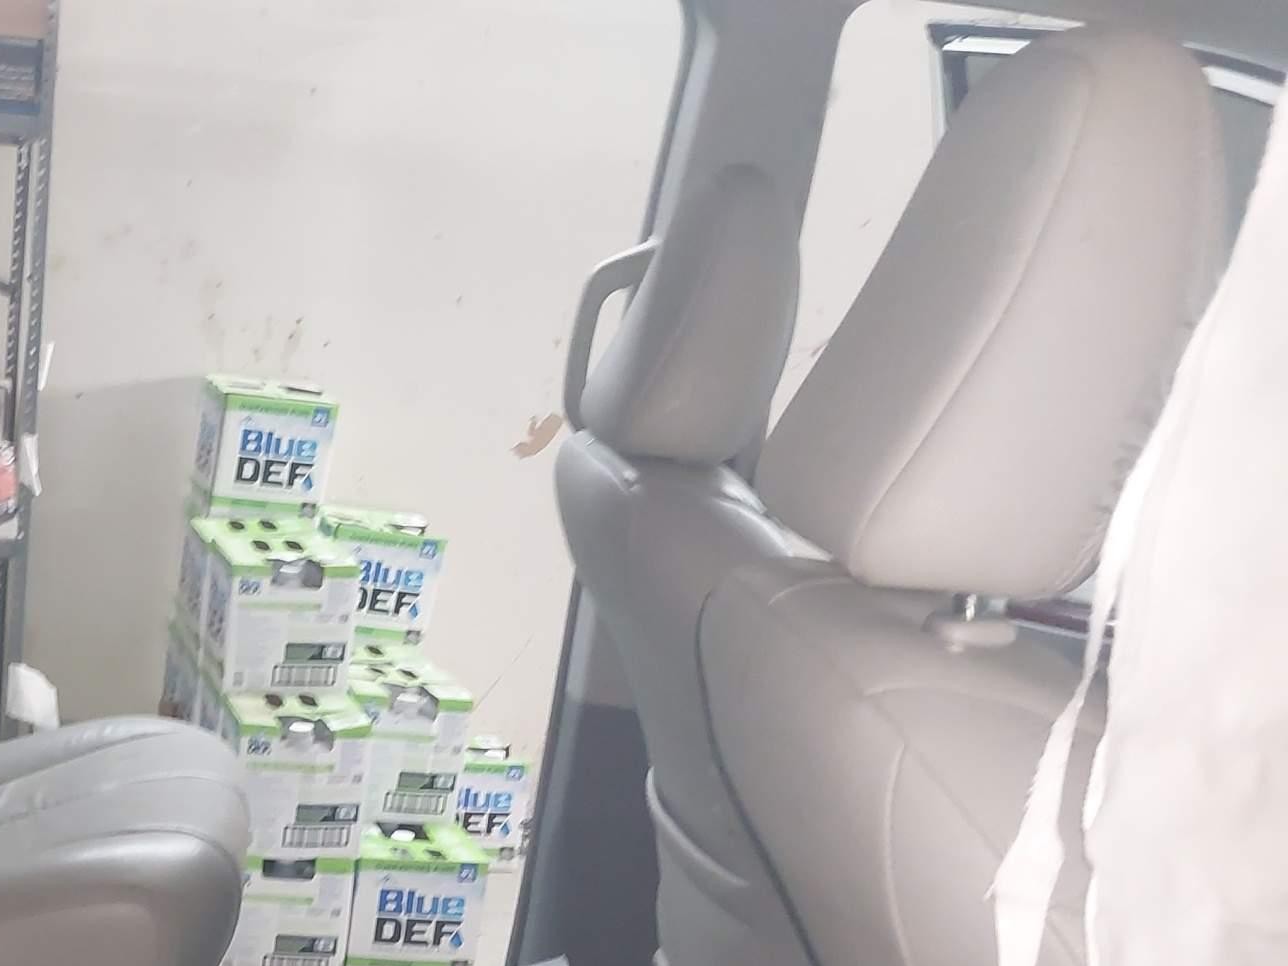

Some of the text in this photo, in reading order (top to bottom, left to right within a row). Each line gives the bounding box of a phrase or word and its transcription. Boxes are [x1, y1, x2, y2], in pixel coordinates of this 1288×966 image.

[240, 428, 317, 458] Blue
[235, 456, 314, 487] DEF
[457, 787, 512, 811] lue
[456, 812, 511, 834] EF
[378, 889, 465, 917] Blue
[374, 917, 464, 947] DEF
